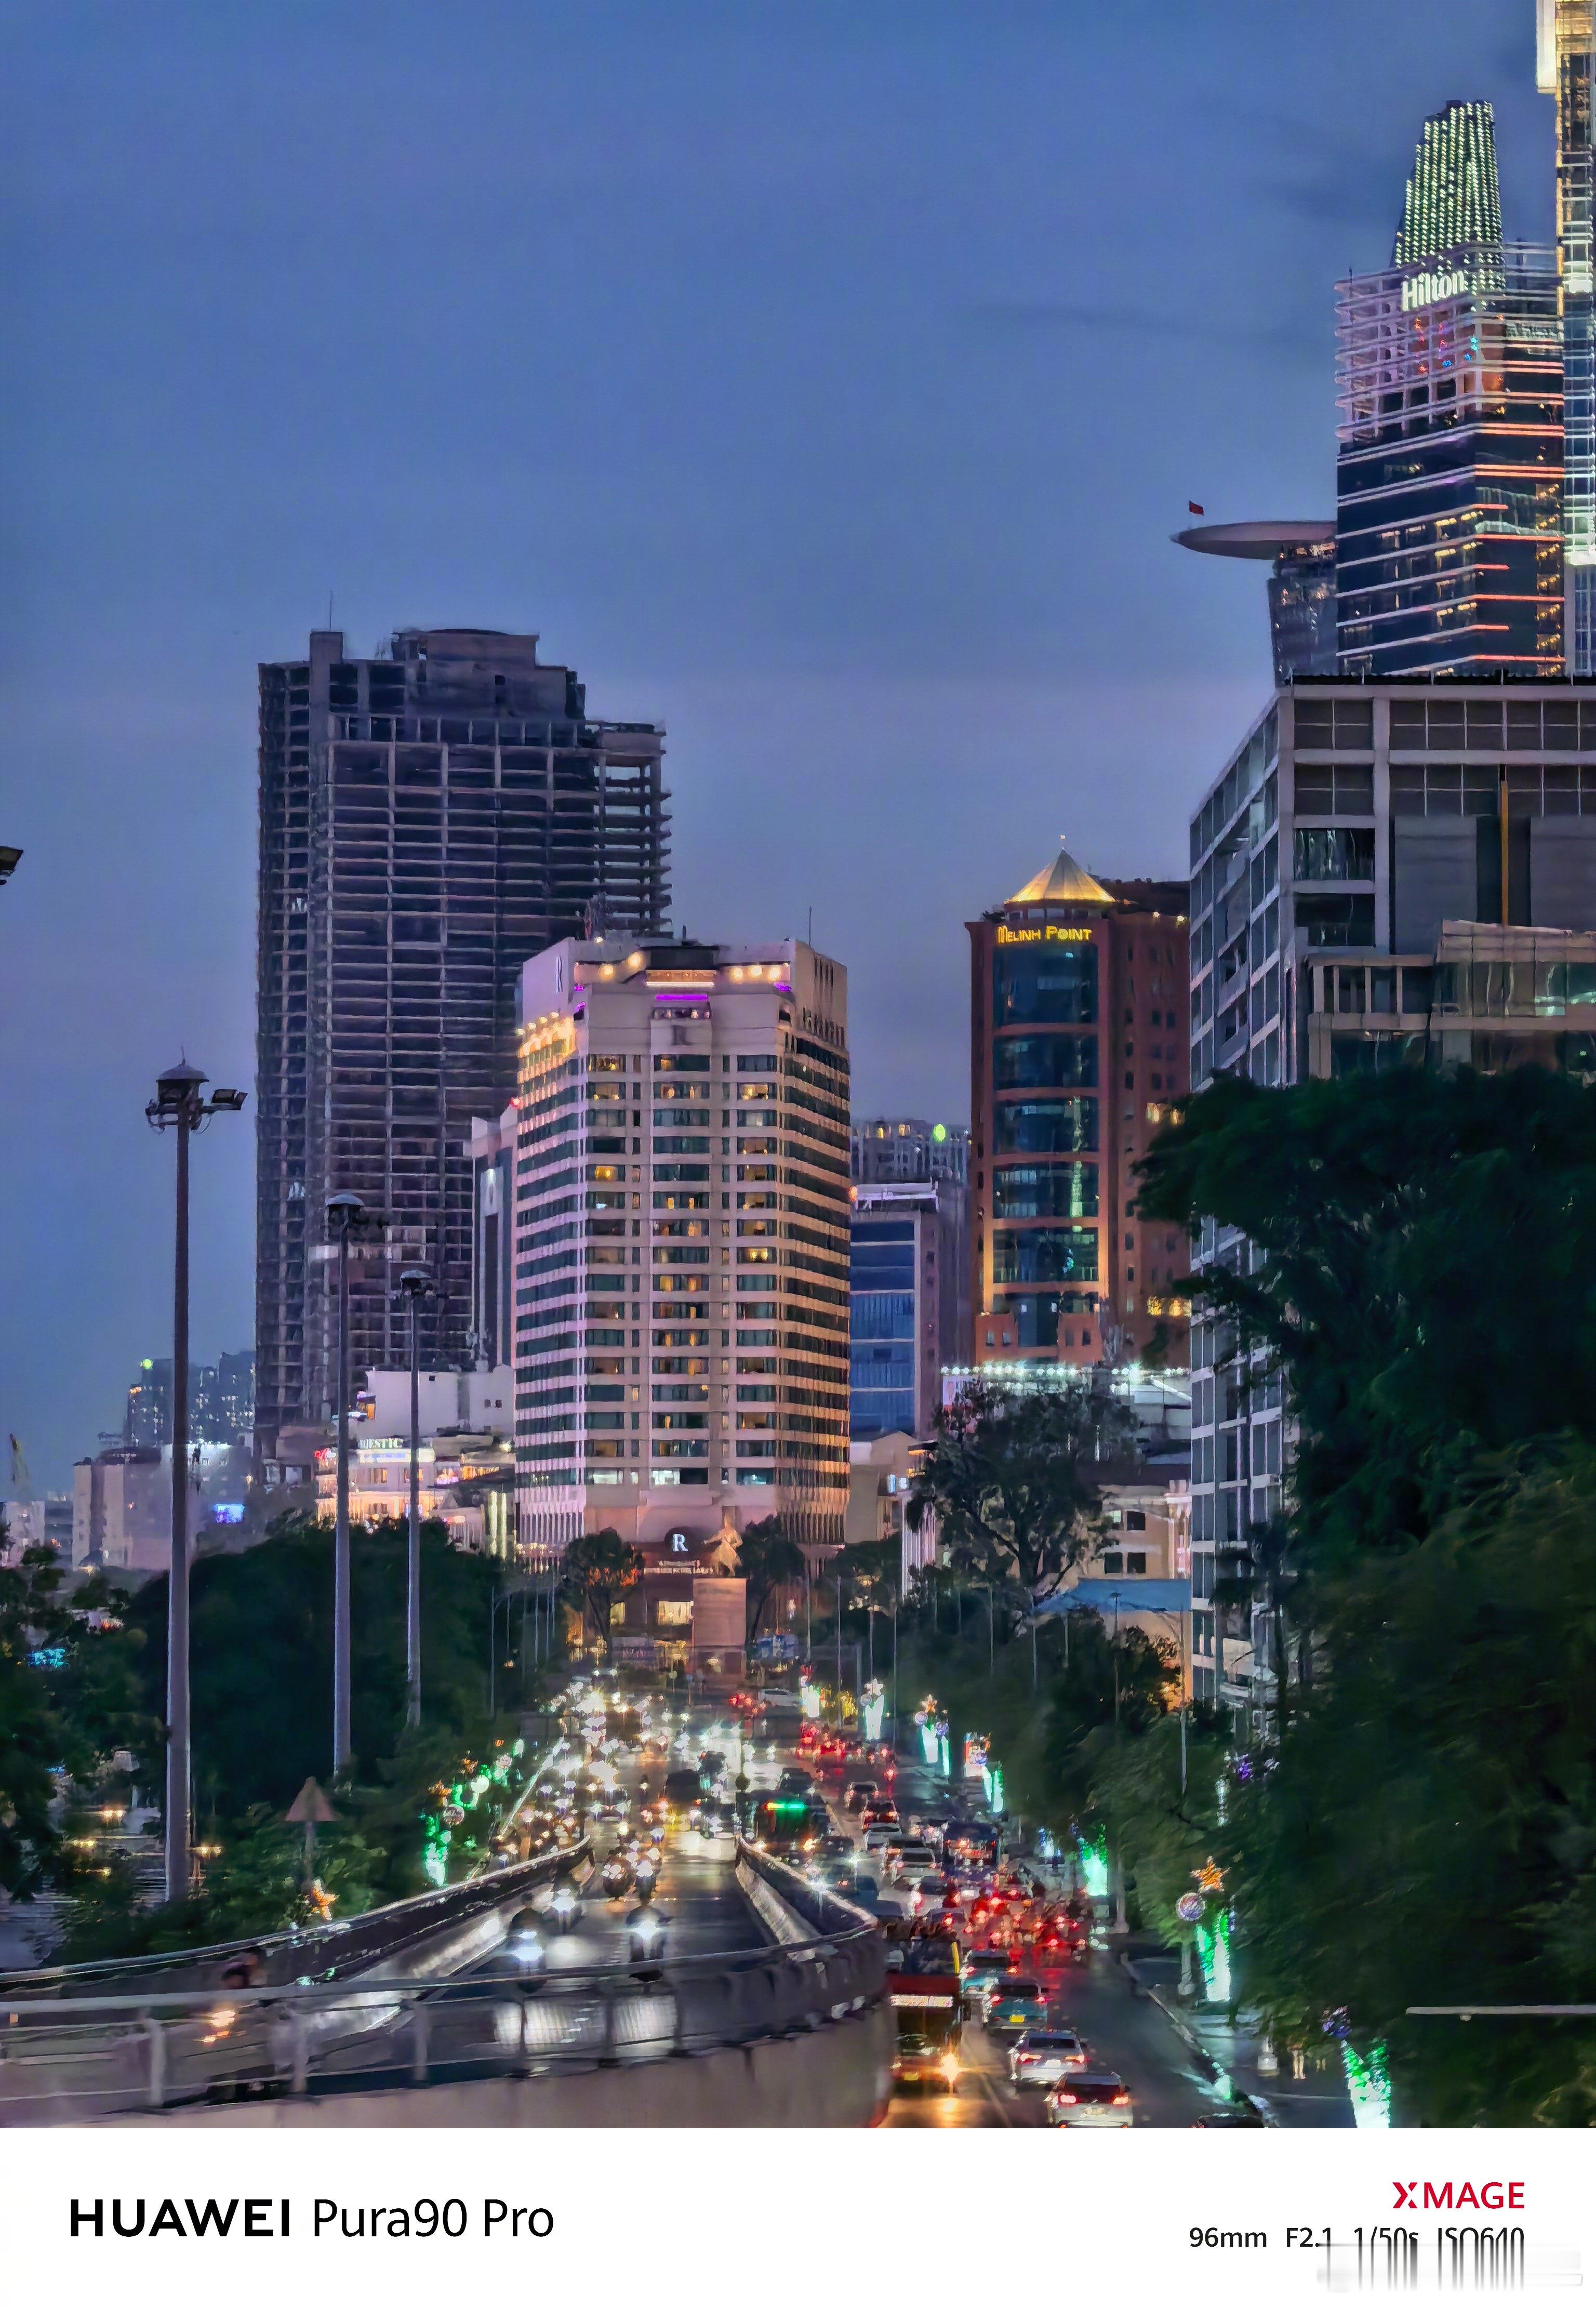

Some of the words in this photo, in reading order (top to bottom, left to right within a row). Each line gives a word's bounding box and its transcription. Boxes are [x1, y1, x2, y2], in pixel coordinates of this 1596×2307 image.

[1402, 271, 1464, 312] Hilton
[998, 925, 1041, 943] MELINH
[1046, 925, 1092, 940] POINT
[673, 1533, 689, 1552] R
